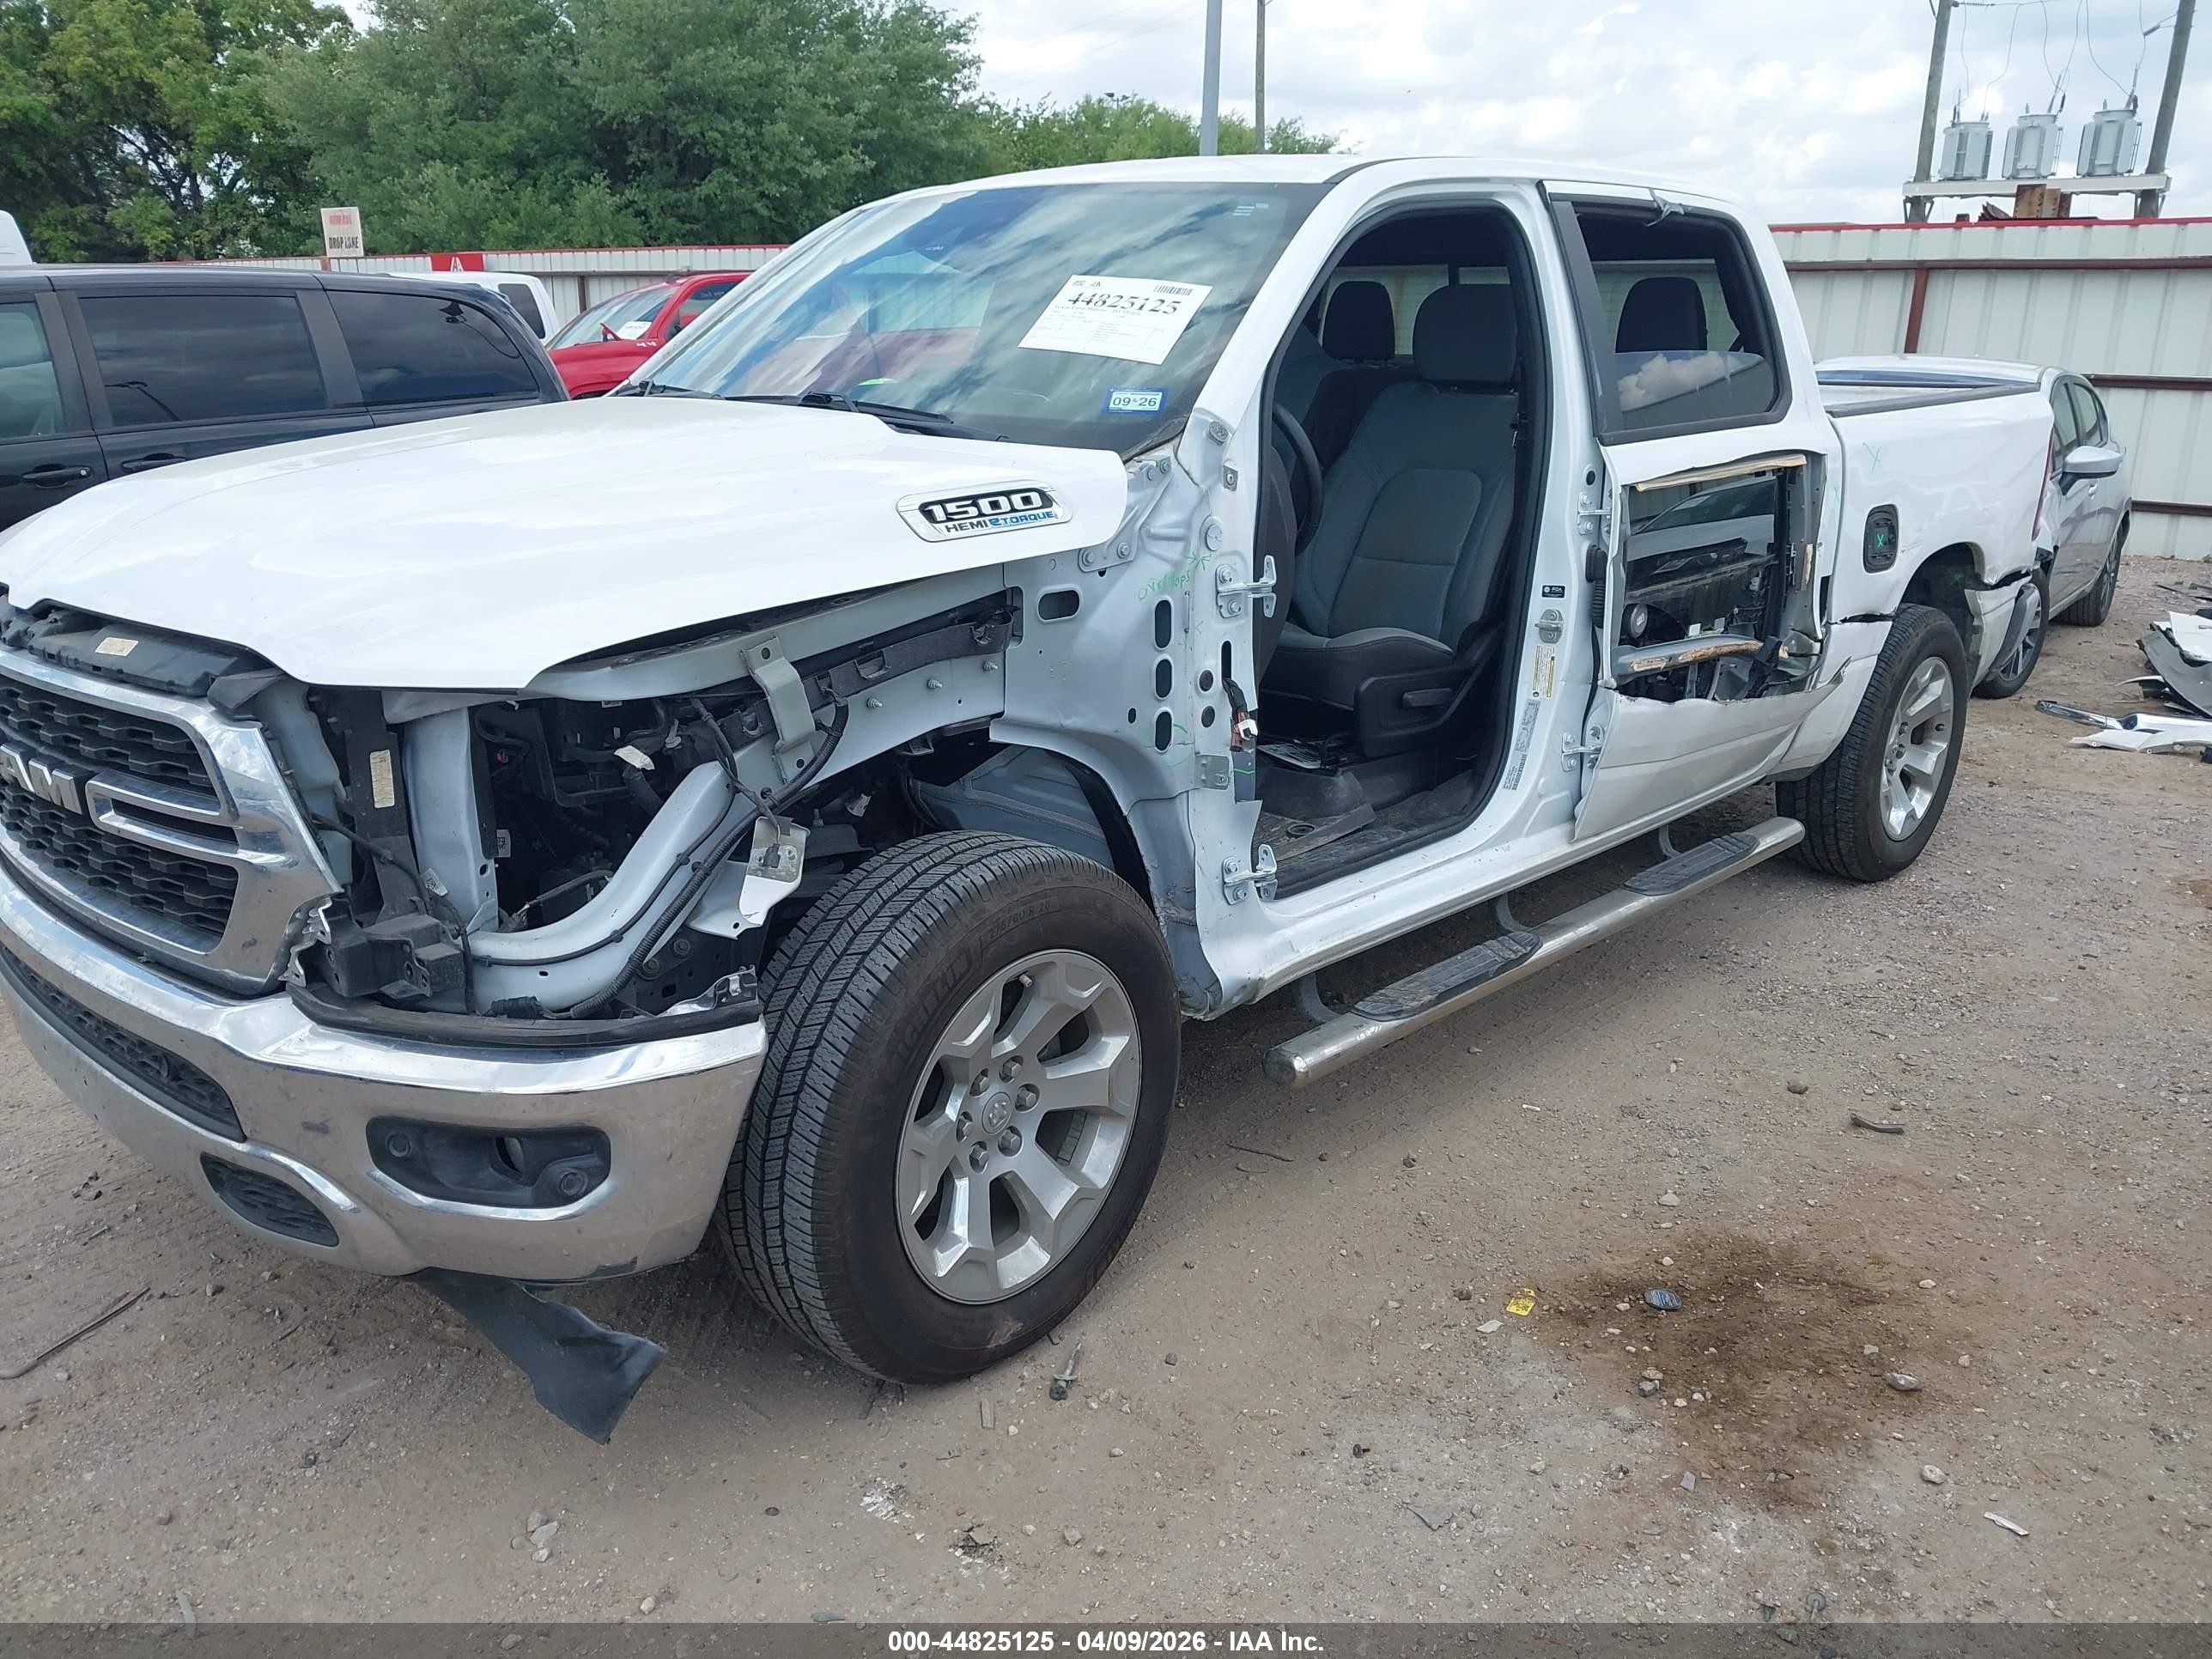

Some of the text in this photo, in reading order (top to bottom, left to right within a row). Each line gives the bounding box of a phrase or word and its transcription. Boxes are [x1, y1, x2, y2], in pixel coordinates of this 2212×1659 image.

[1067, 292, 1182, 315] 44825125
[1113, 397, 1157, 407] 09 26
[924, 491, 1042, 522] 1500
[945, 520, 988, 532] HEMI
[0, 744, 82, 815] AM
